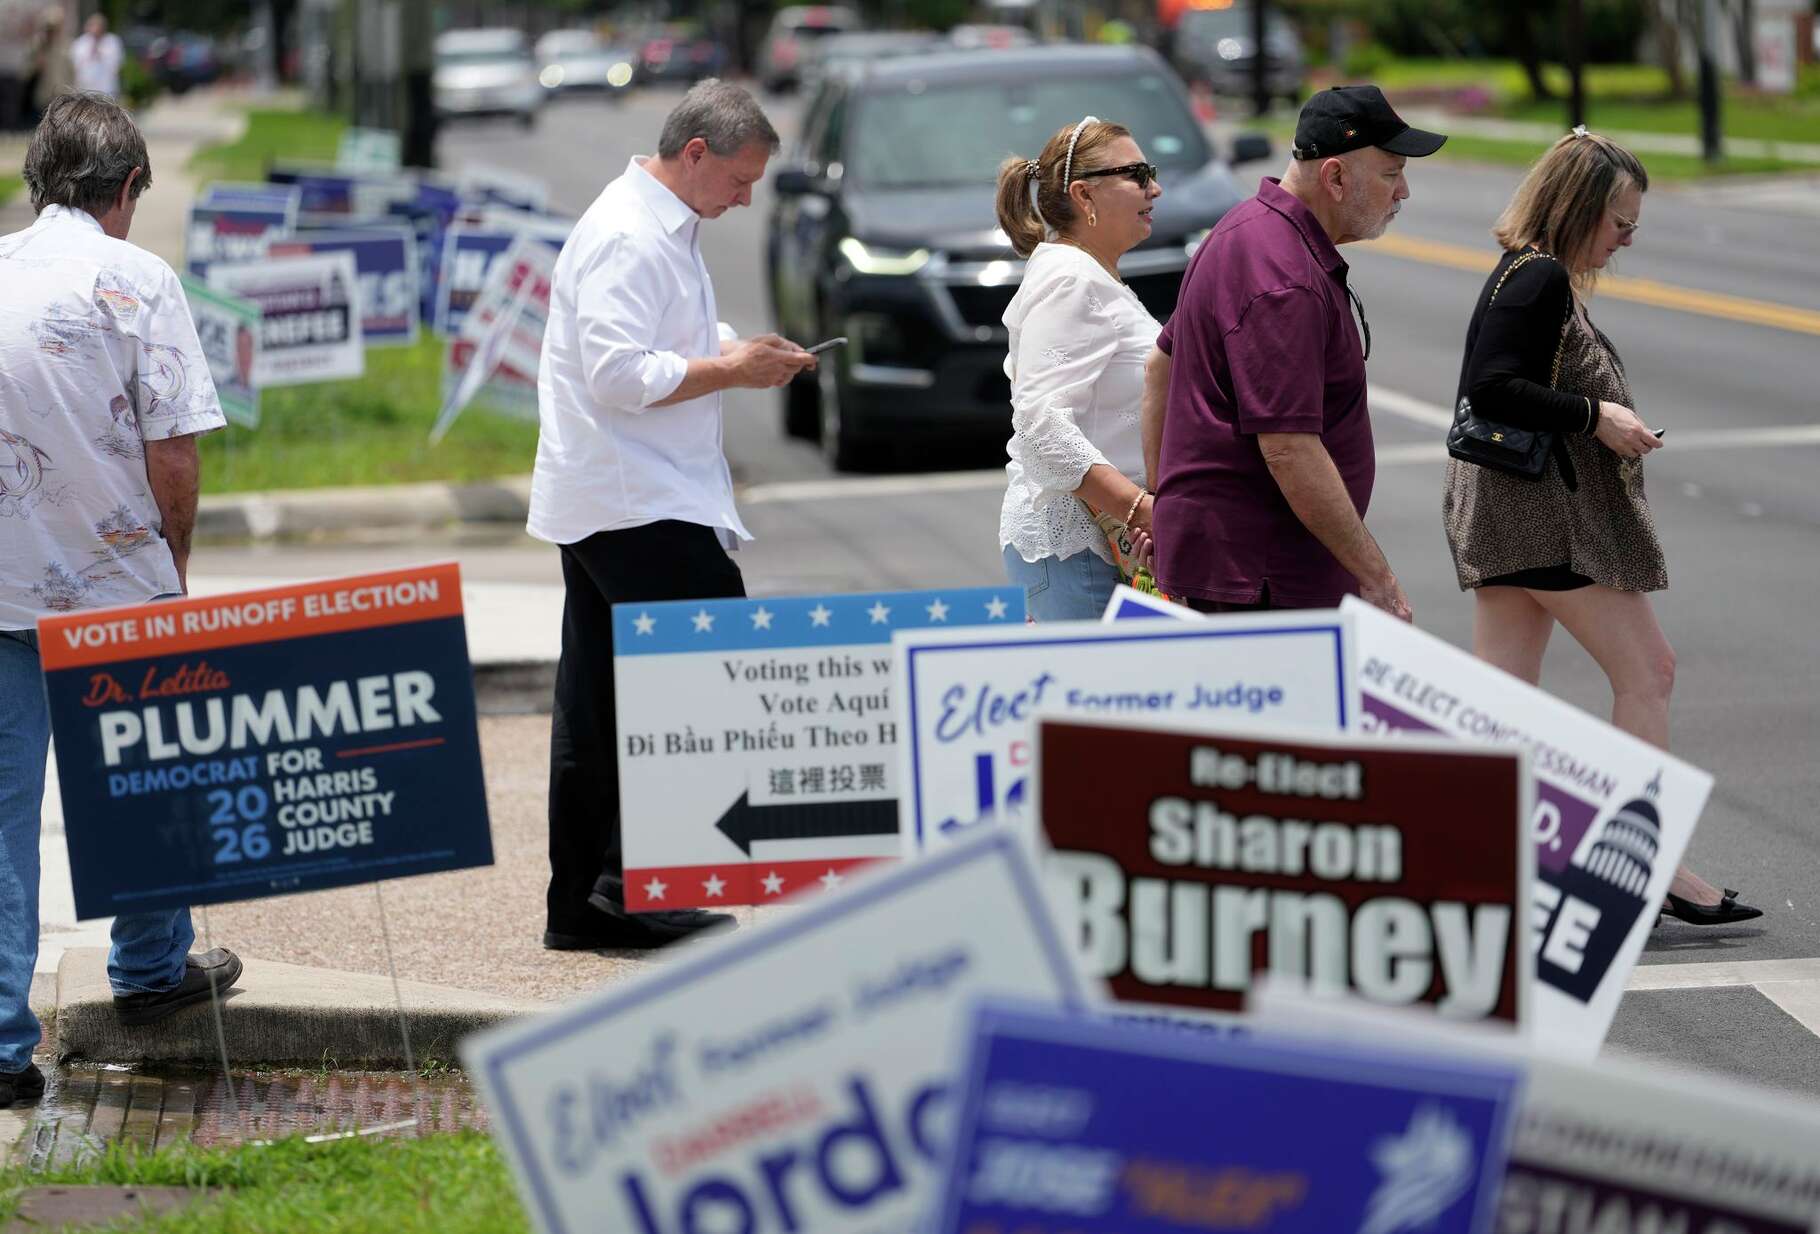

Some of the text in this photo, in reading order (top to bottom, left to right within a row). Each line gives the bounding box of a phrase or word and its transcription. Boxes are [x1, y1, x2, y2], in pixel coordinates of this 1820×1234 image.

[63, 579, 439, 649] VOTE IN RUNOFF ELECTION
[82, 661, 231, 708] Dr. Letitia
[723, 659, 809, 684] Voting
[818, 655, 863, 678] this
[99, 671, 442, 767] PLUMMER
[759, 687, 889, 718] Vote Aquí
[935, 671, 1285, 744] Elect Former Judge
[627, 734, 655, 757] Đi
[665, 725, 713, 755] Bầu
[724, 721, 795, 752] Phiếu
[804, 725, 868, 748] Theo
[1362, 657, 1617, 798] RE-ELECT CONESSMAN
[108, 748, 323, 797] DEMOCRAT FOR
[274, 767, 377, 803] HARRIS
[768, 763, 886, 795] 這裡投票
[1190, 745, 1362, 799] Re-Elect
[208, 785, 267, 826] 20
[277, 792, 394, 828] COUNTY
[212, 826, 271, 864] 26
[283, 823, 373, 856] JUDGE
[1148, 797, 1402, 883] Sharon
[1048, 849, 1512, 1022] Burney
